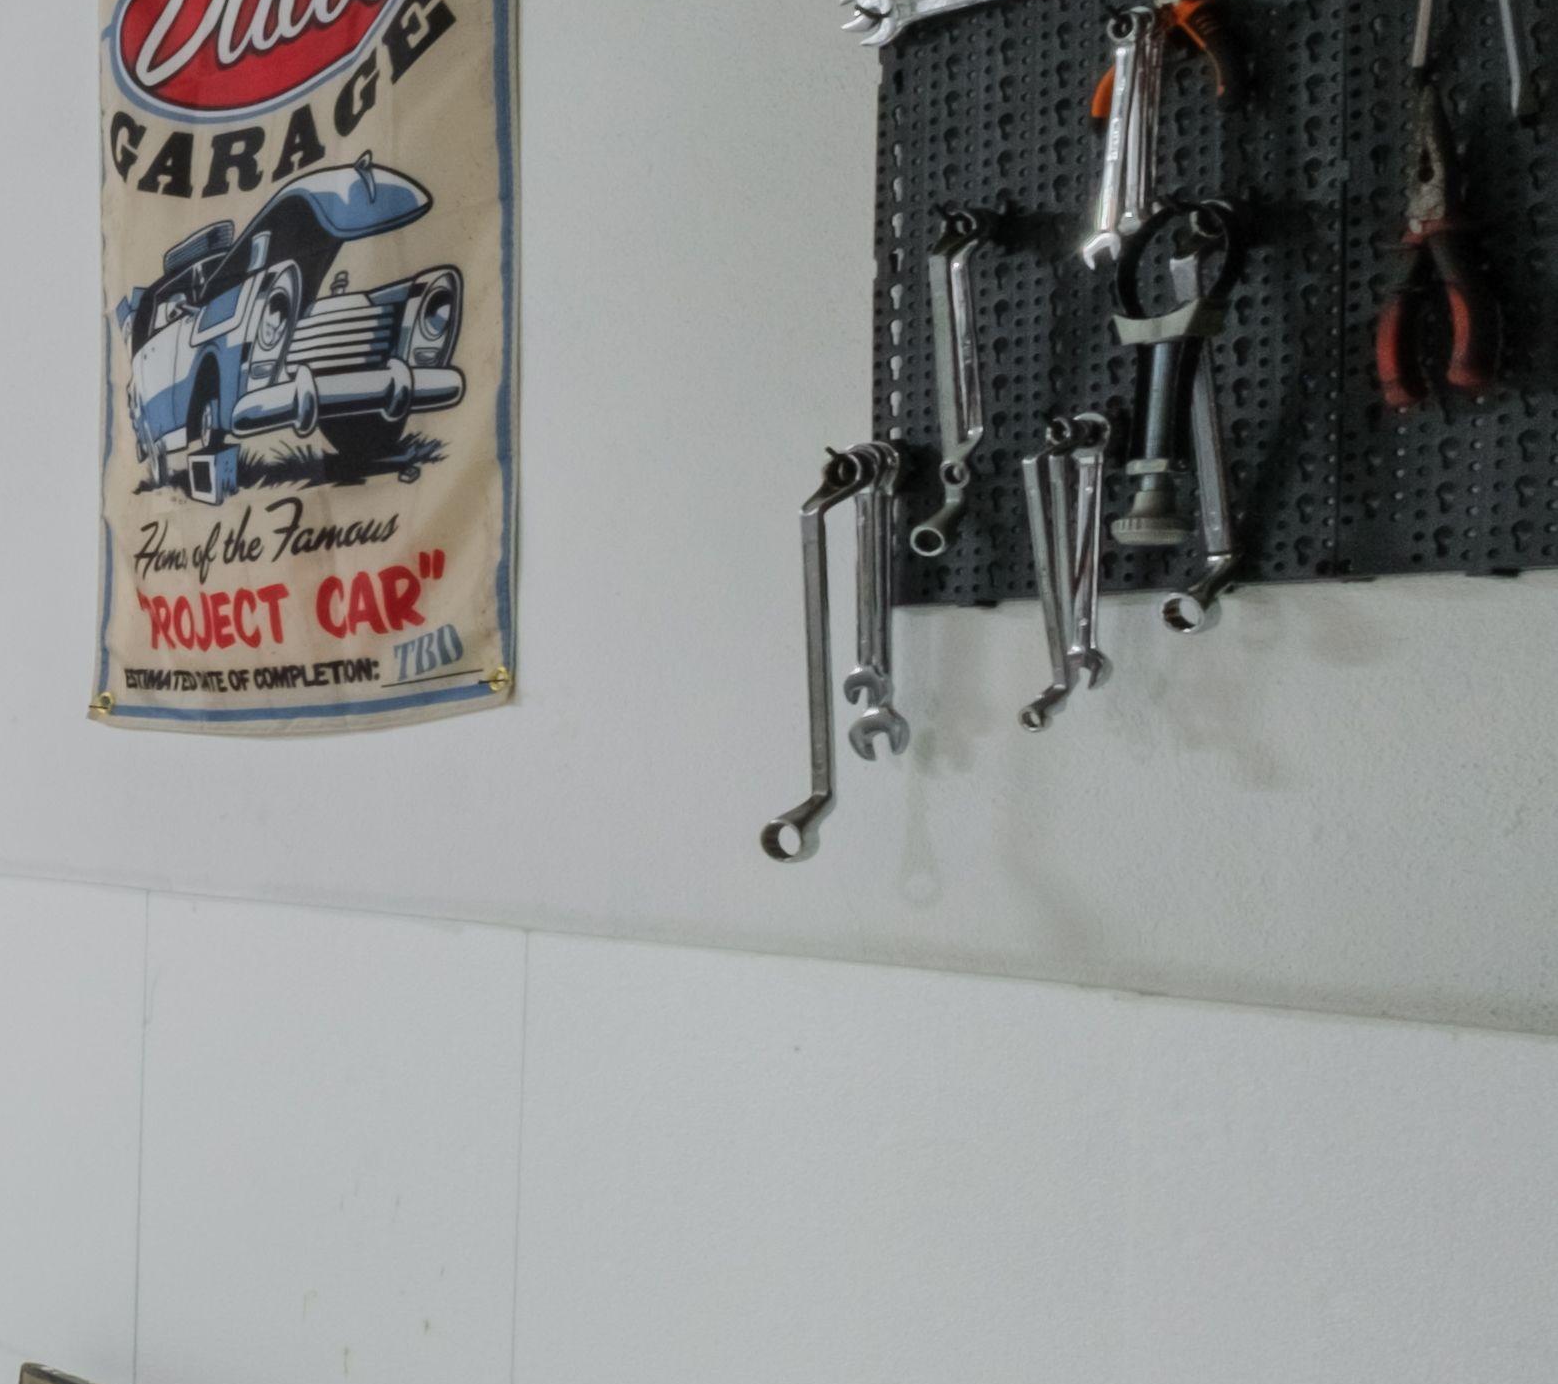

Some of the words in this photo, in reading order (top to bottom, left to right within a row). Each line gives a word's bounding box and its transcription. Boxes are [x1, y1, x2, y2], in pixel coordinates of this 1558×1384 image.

[223, 505, 265, 563] the
[265, 496, 400, 564] Famous
[124, 667, 198, 691] ESTIMATED
[227, 666, 249, 692] OF
